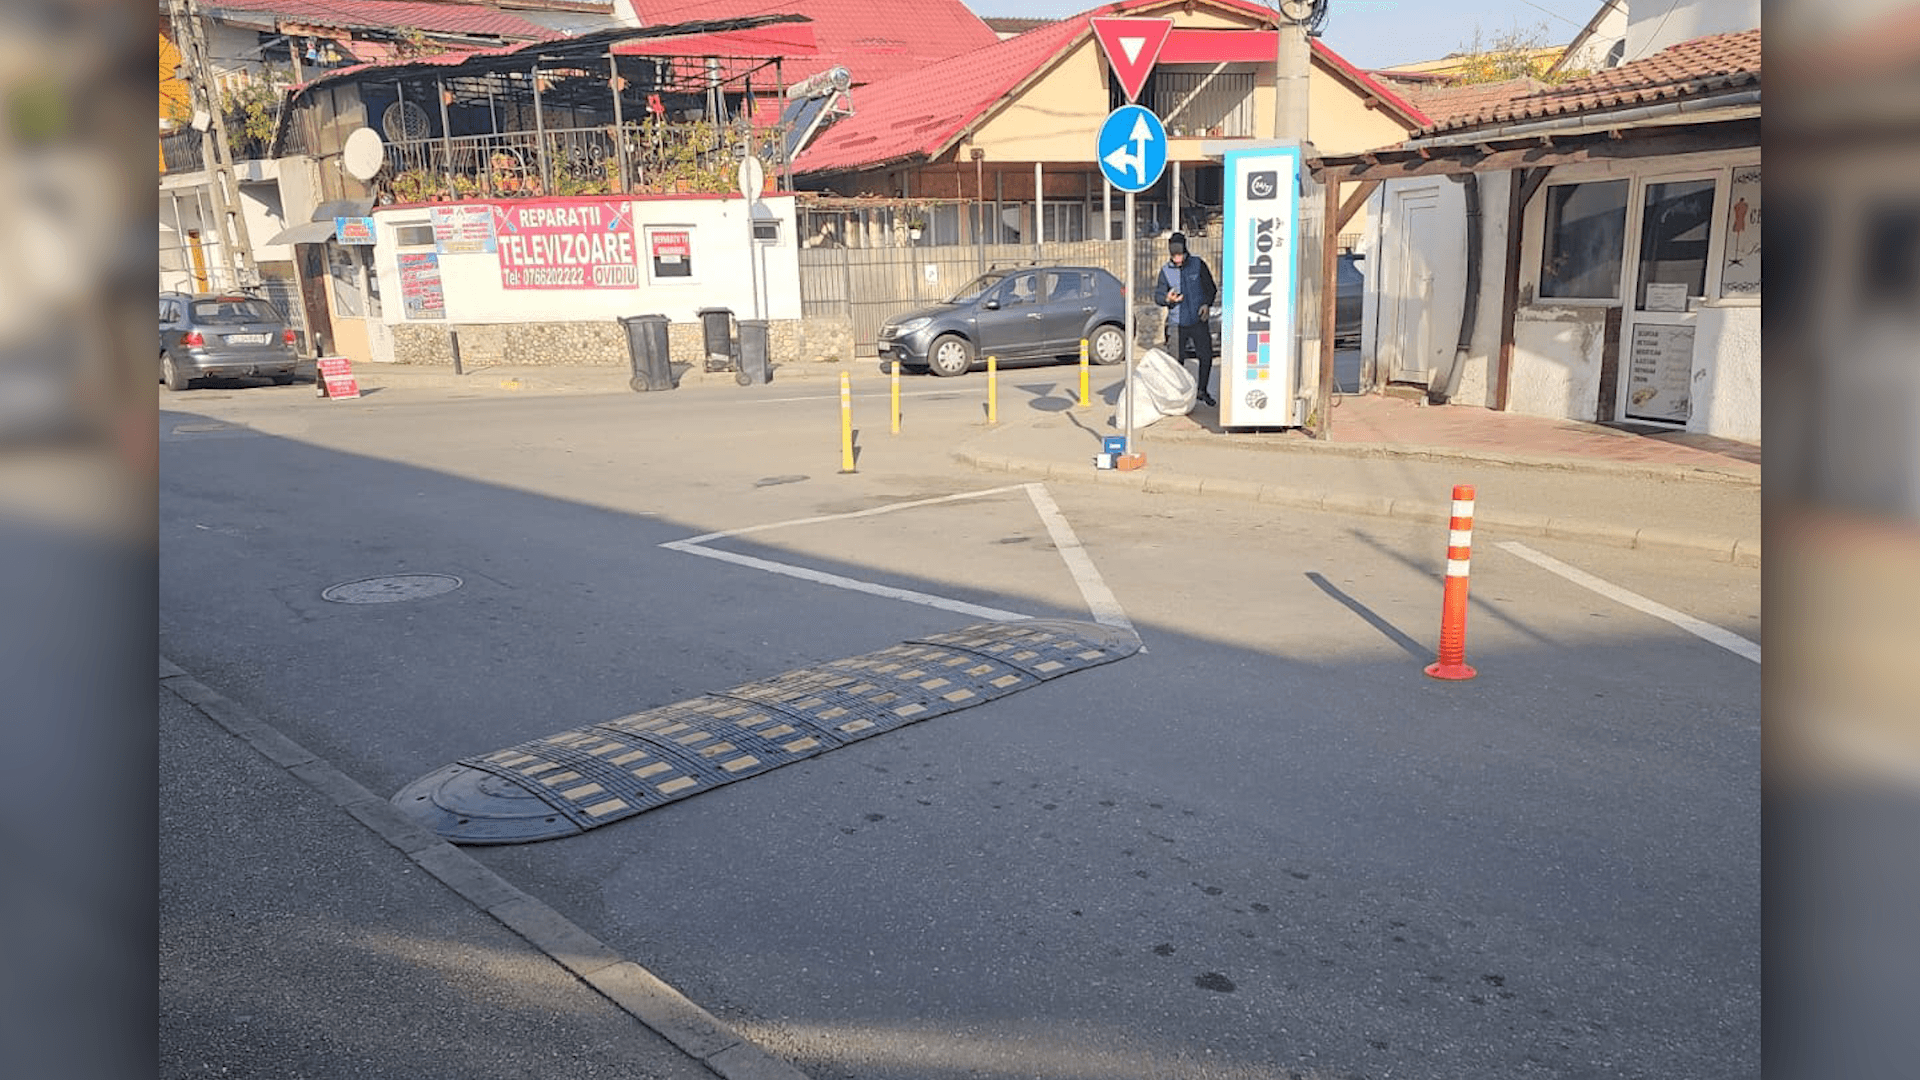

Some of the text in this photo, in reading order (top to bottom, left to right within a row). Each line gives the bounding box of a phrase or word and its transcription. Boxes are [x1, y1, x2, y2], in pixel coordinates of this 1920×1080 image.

[499, 233, 634, 265] TELEVIZOARE
[595, 266, 636, 284] OVIDIU
[1247, 217, 1274, 332] FANbox
